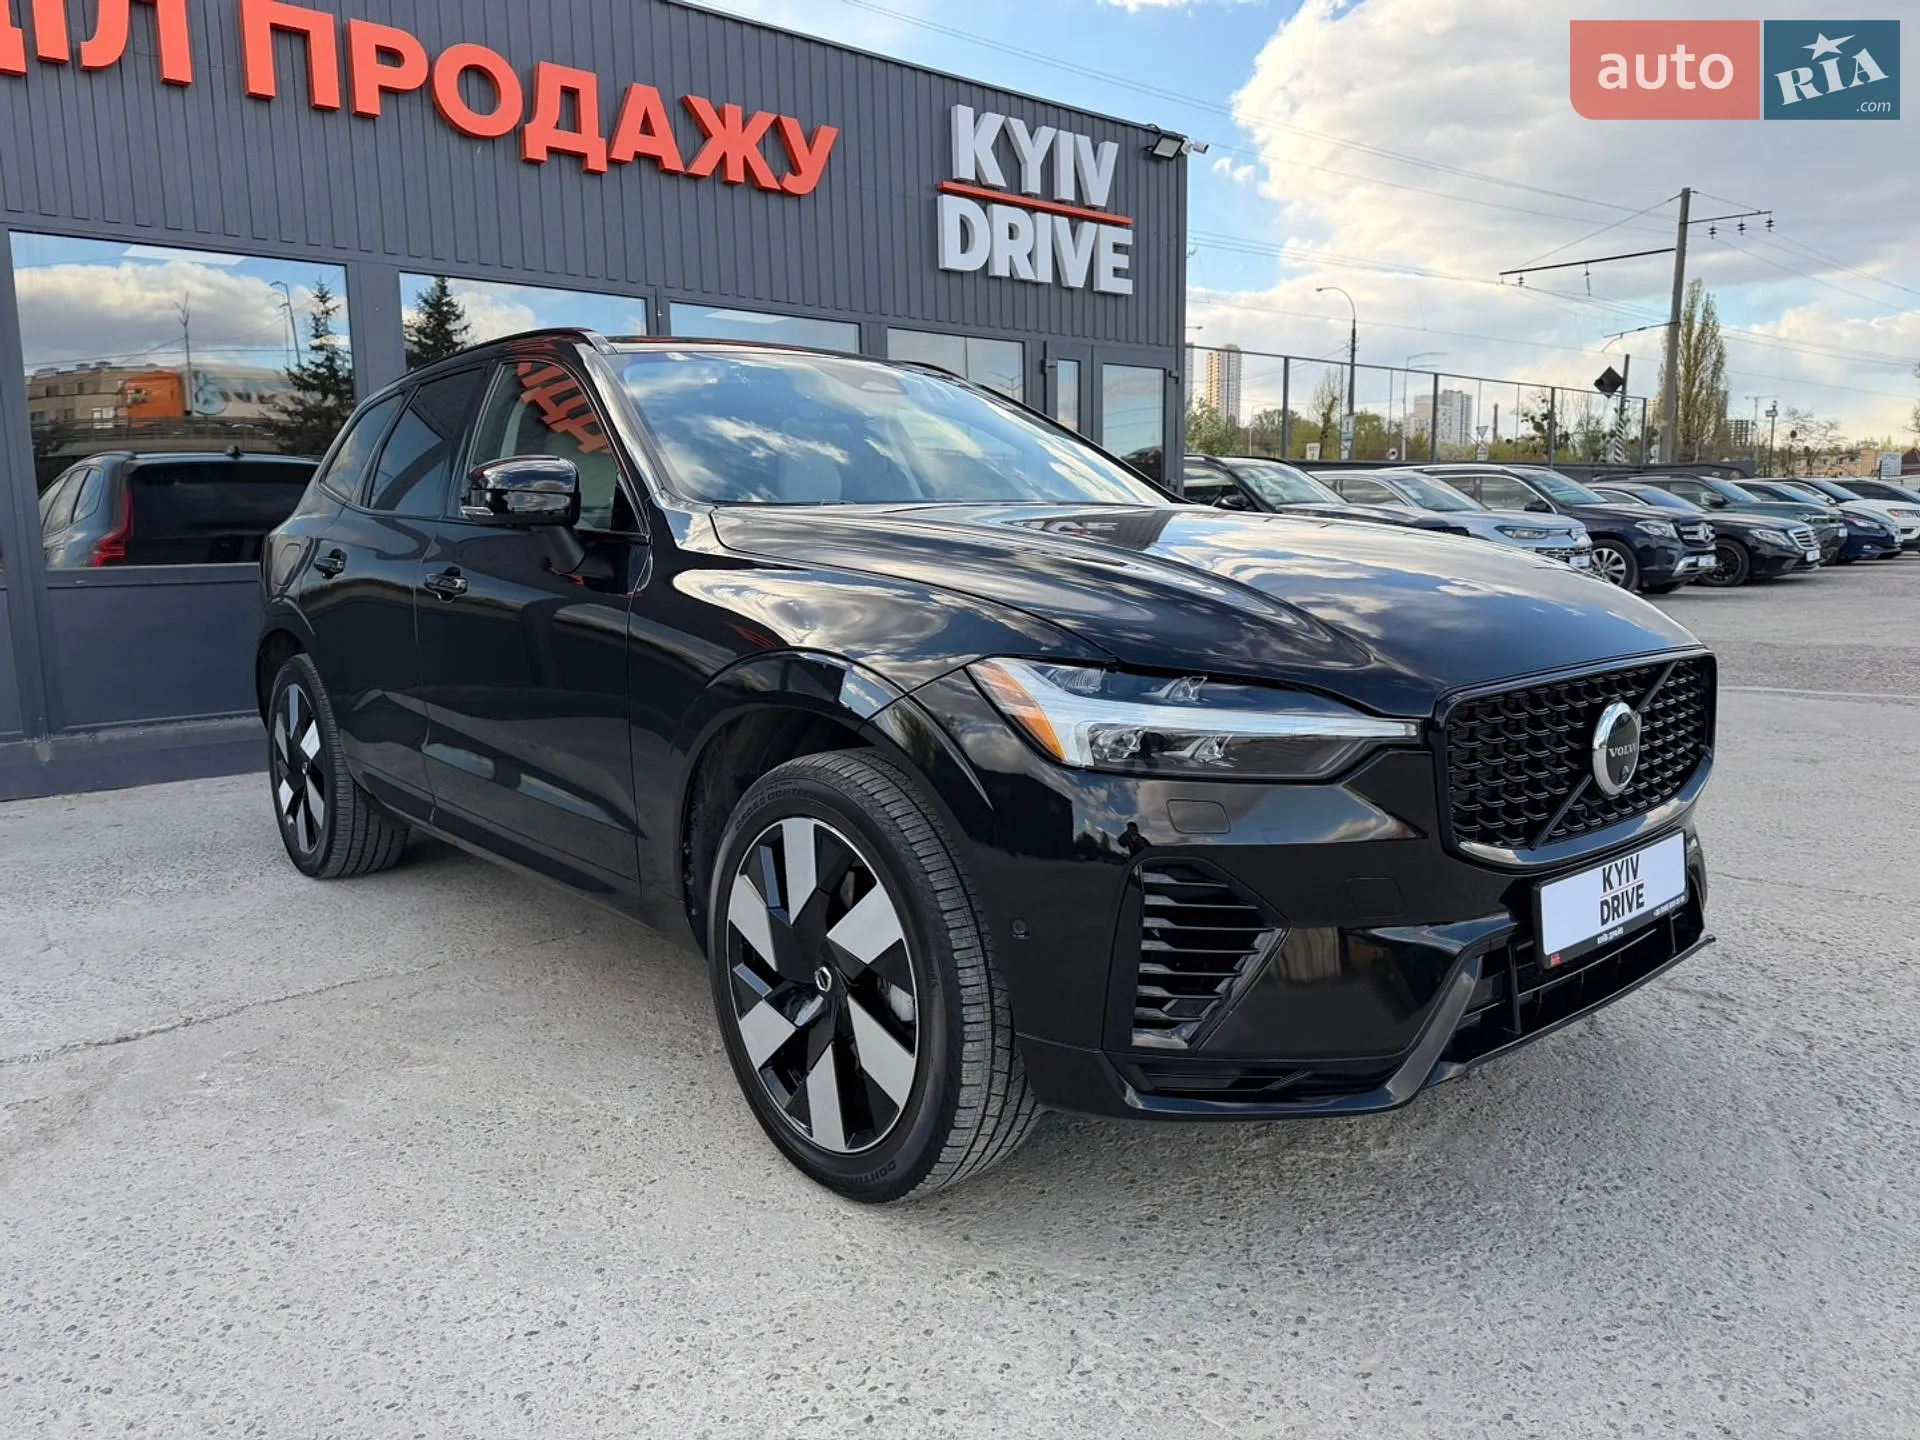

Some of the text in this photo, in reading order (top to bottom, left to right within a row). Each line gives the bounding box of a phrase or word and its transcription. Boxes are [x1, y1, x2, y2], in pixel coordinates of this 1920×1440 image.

[0, 0, 838, 196] ІЛ ПРОДАЖУ
[951, 104, 1119, 208] KYIV
[937, 194, 1133, 295] DRIVE
[1600, 883, 1645, 926] DRIVE
[1602, 854, 1640, 893] KYIV
